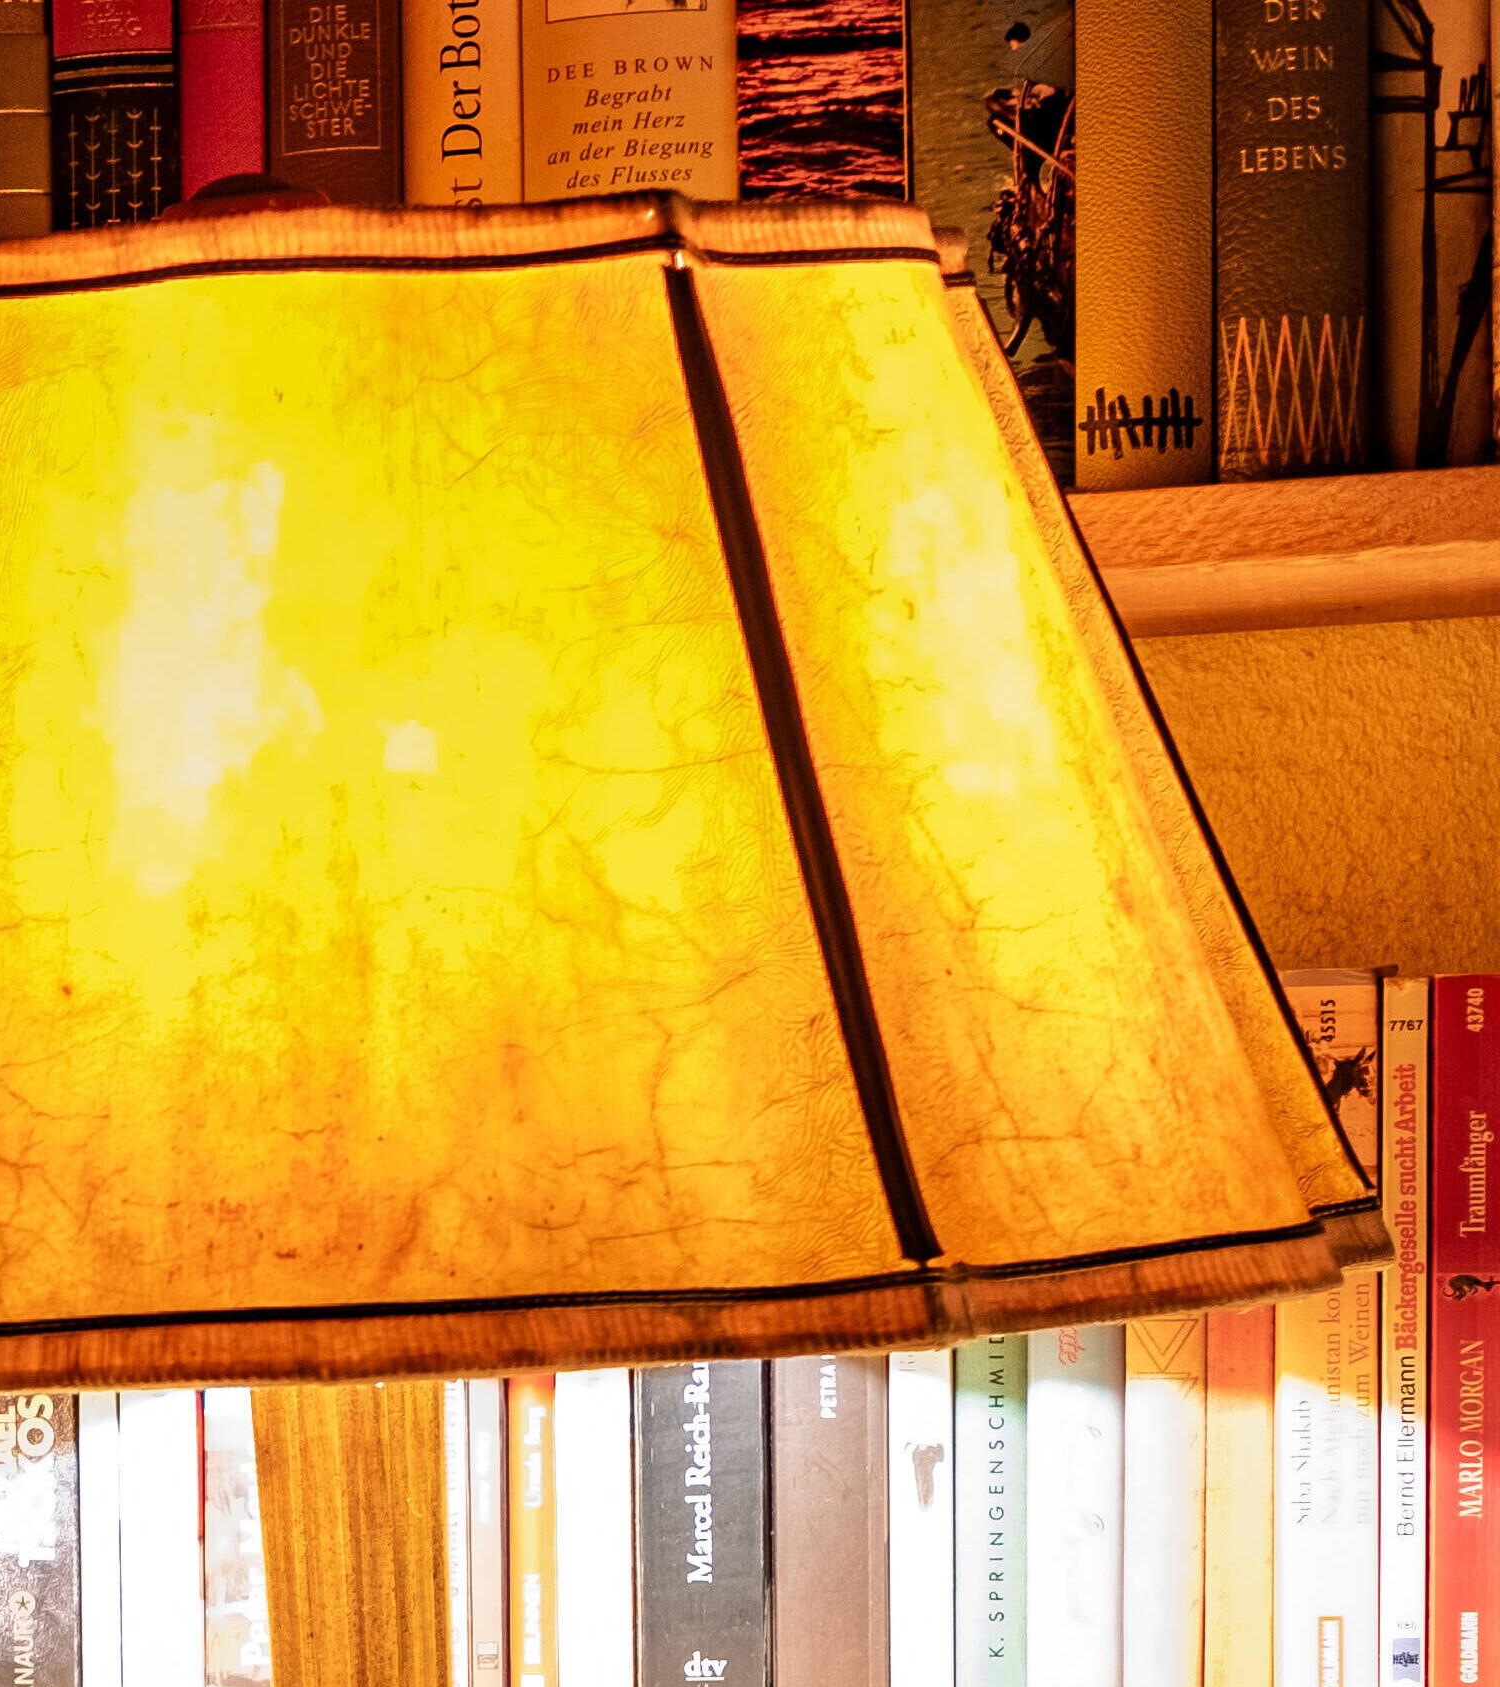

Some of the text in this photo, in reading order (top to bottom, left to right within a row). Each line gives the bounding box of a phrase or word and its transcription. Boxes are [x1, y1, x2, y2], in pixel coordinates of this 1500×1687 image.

[308, 4, 348, 24] DIE
[289, 22, 372, 45] DUNKLE
[304, 41, 353, 62] UND
[1251, 45, 1335, 73] WEIN
[309, 61, 348, 80] DIE
[547, 55, 714, 84] DEE BROWN
[293, 79, 371, 102] LICHTE
[584, 84, 673, 111] Begrabt
[289, 99, 372, 122] SCHWE-
[441, 80, 483, 162] Der
[1267, 96, 1322, 123] DES
[306, 117, 357, 140] STER
[571, 111, 686, 137] mein Herz
[547, 138, 713, 167] an der Biegung
[1240, 146, 1348, 174] LEBENS
[565, 165, 693, 190] des Flusses
[1466, 986, 1484, 1033] 43740
[1388, 1018, 1424, 1032] 7767
[1458, 1109, 1495, 1238] Traumfänger
[1392, 1064, 1425, 1537] Bernd Ellermann Bäckergeselle sucht Arbeit
[819, 1364, 837, 1419] PETRA
[1458, 1339, 1485, 1518] MARLO MORGAN
[683, 1494, 713, 1585] Marcel
